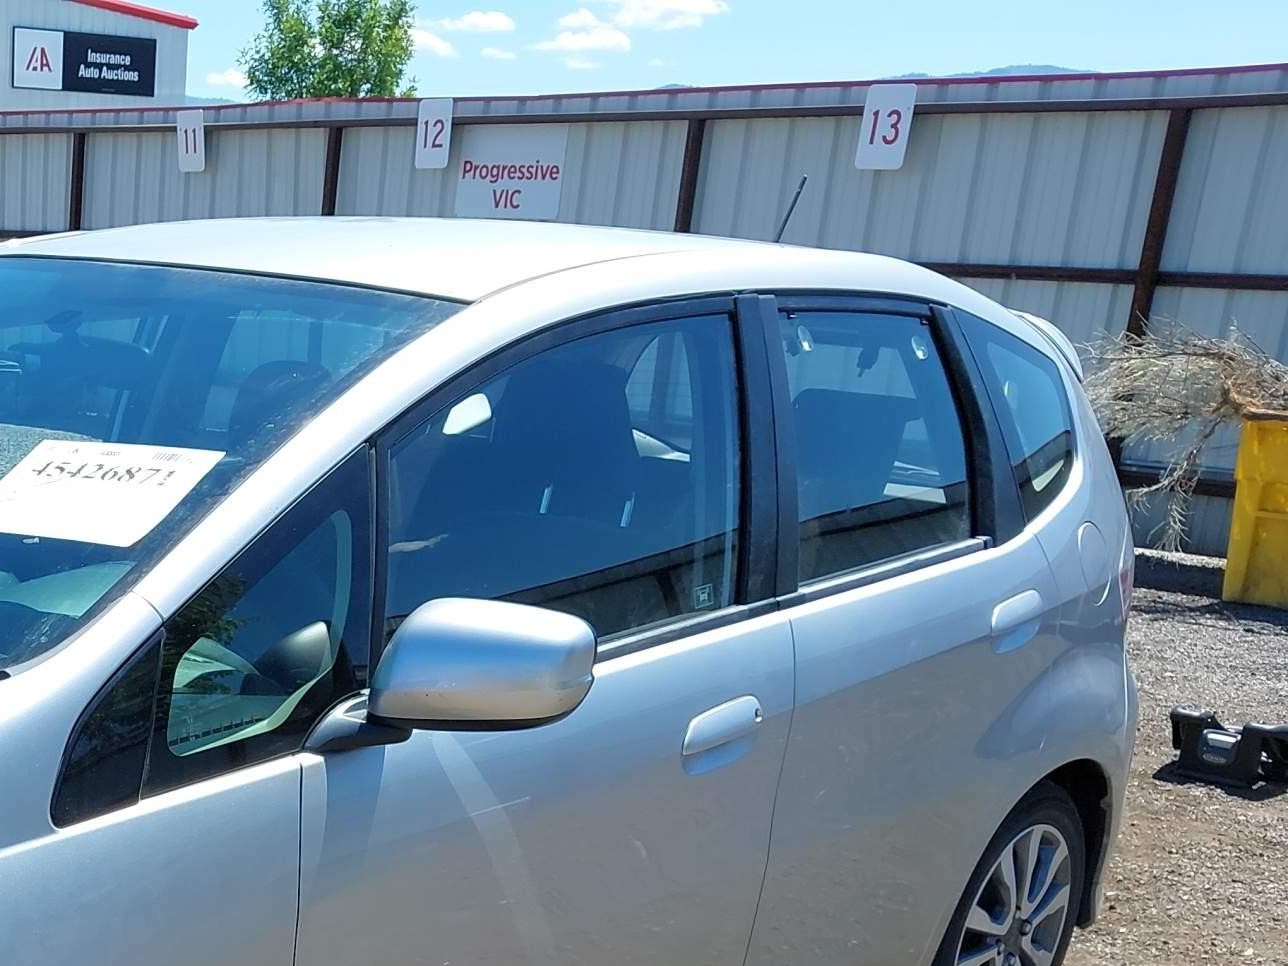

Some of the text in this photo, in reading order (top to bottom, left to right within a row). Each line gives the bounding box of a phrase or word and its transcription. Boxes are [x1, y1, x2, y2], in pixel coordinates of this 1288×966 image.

[87, 48, 131, 66] Insurance
[78, 63, 140, 82] Auto Auctions
[422, 118, 446, 150] 12
[868, 108, 903, 146] 13
[182, 128, 199, 155] 11
[461, 158, 560, 184] Progressive
[491, 188, 522, 209] VIC
